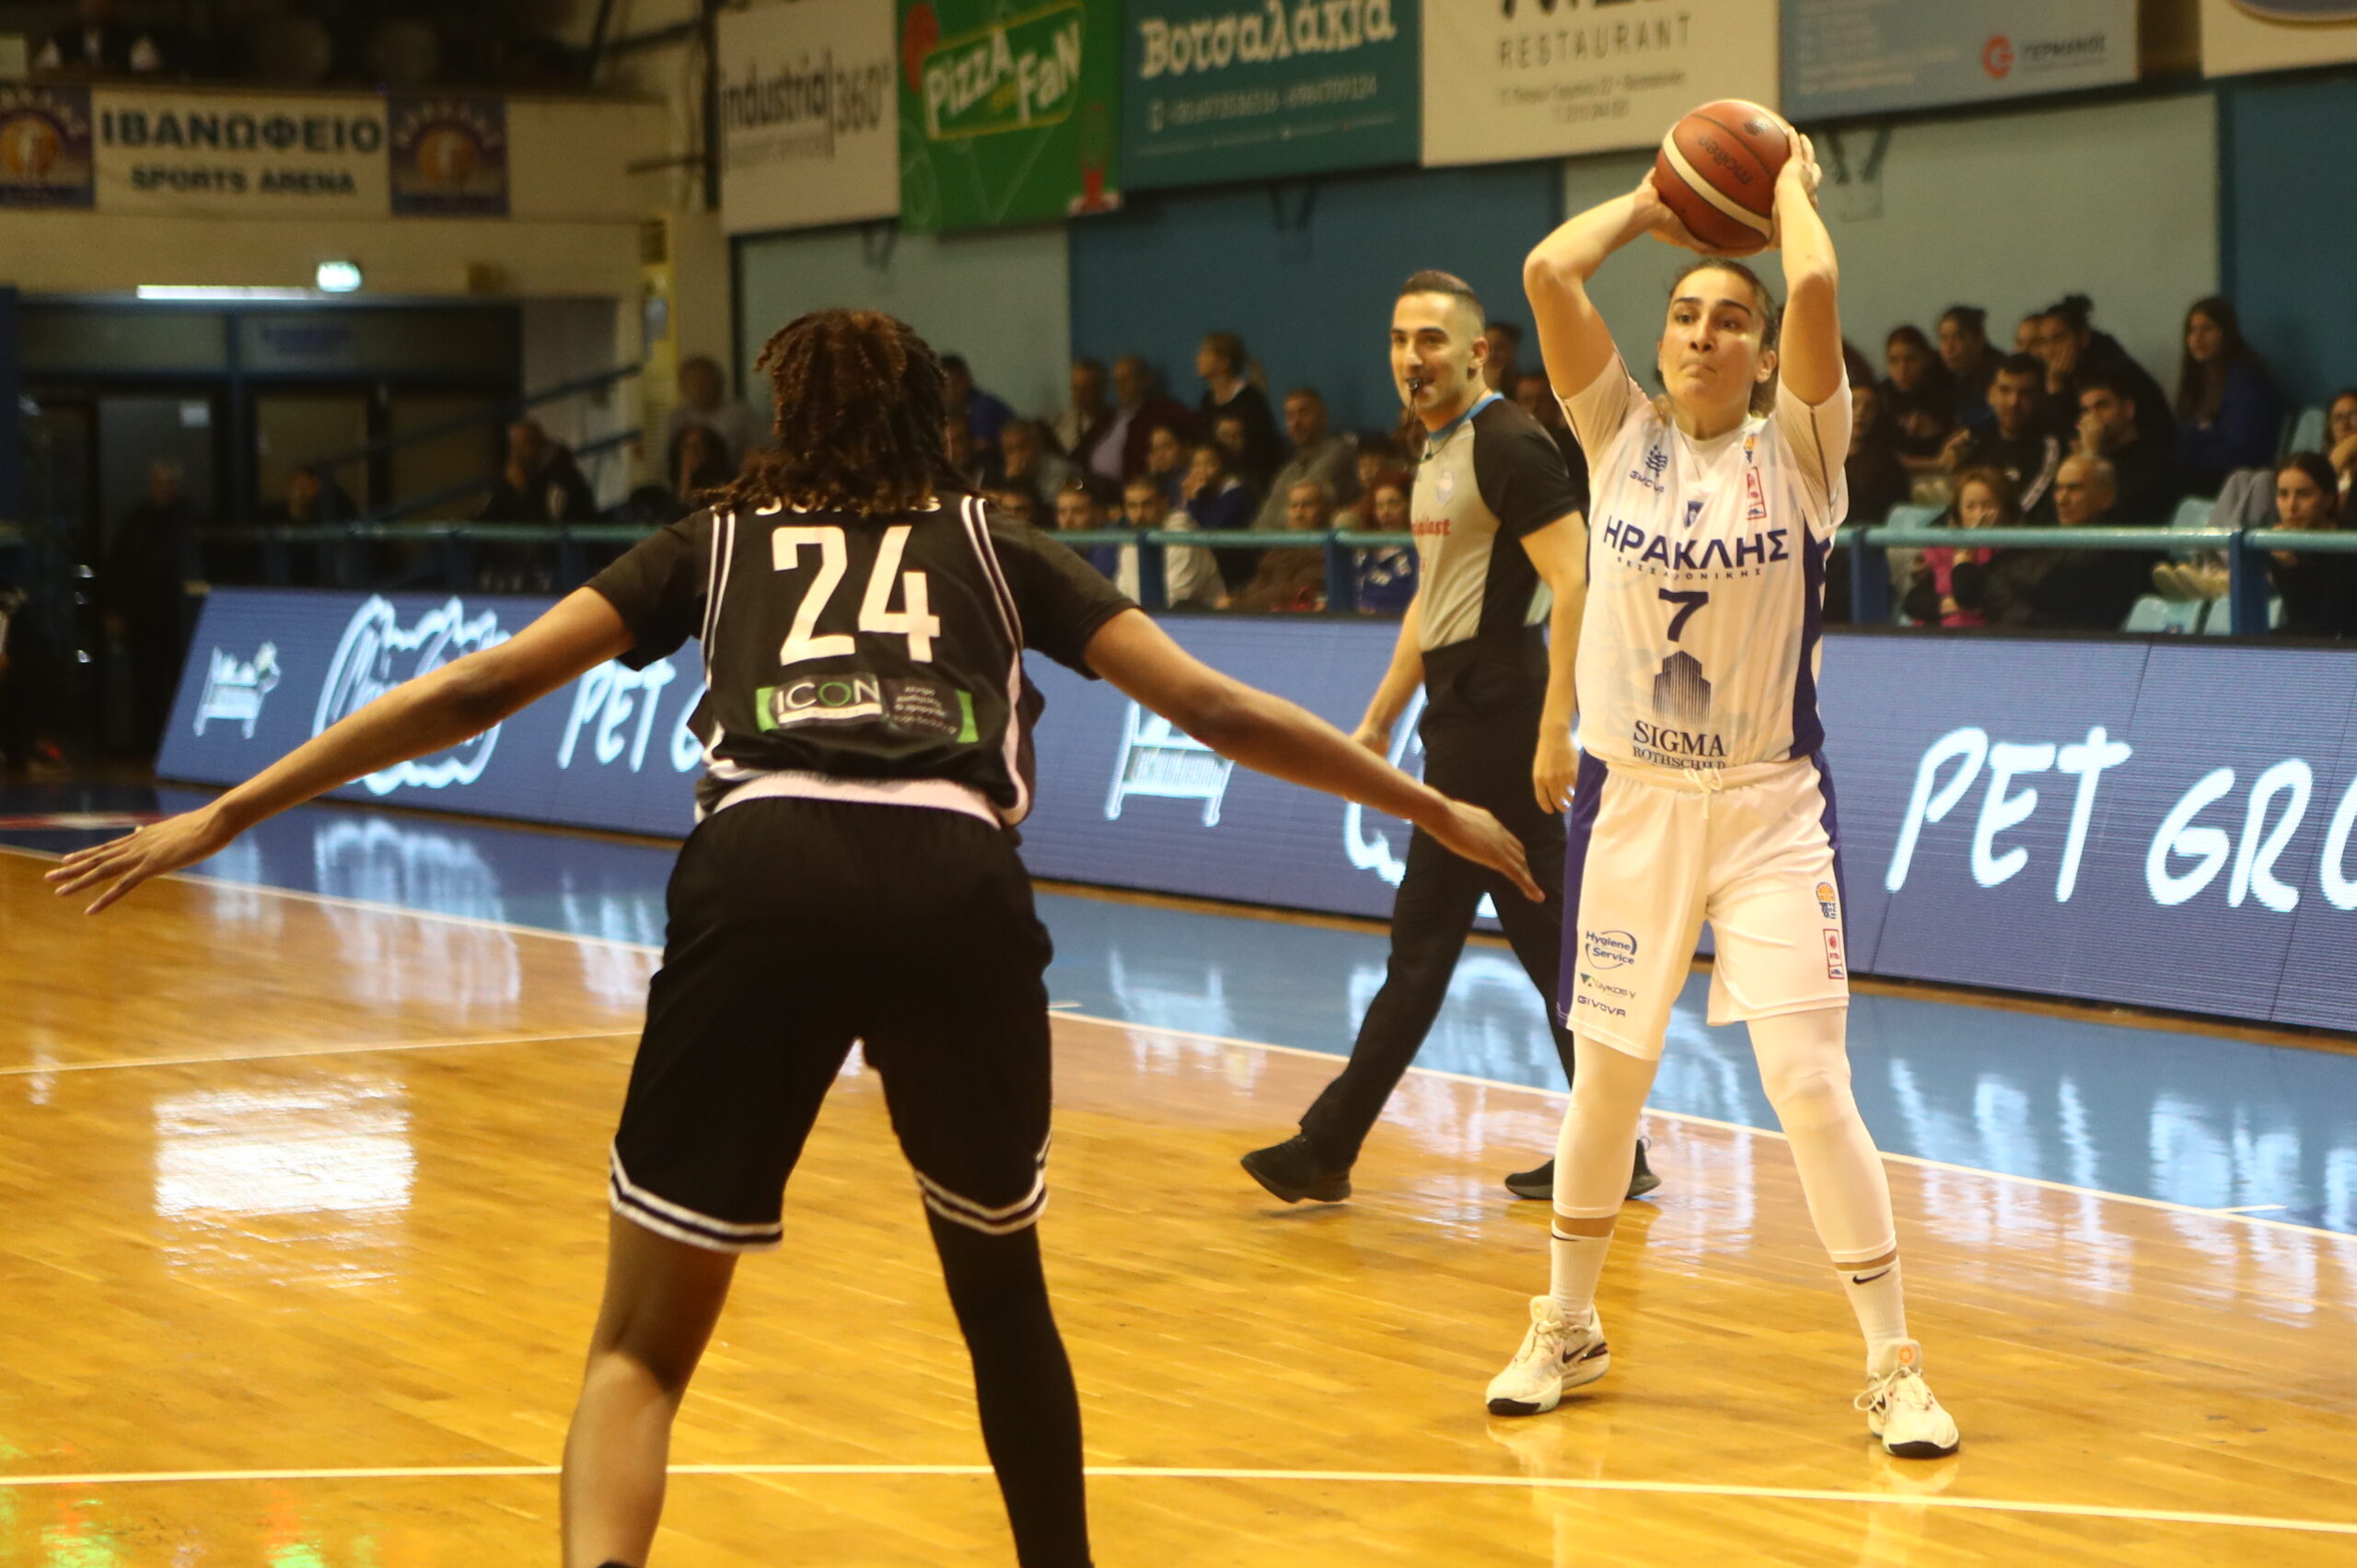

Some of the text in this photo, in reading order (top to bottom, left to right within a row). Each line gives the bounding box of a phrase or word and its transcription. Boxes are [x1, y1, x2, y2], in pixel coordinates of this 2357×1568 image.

[1498, 12, 1690, 69] RESTAURANT
[101, 109, 382, 154] ΙΒΑΝΩΦΕΙΟ
[131, 166, 357, 195] SPORTS ARENA
[1603, 514, 1789, 571] ΗΡΑΚΛΗΣ
[772, 526, 941, 667] 24
[1658, 587, 1710, 643] 7
[557, 656, 677, 773] PET
[777, 679, 881, 714] ICON
[1632, 719, 1727, 758] SIGMA
[1886, 726, 2133, 902] PET
[1585, 931, 1631, 951] Hygiene
[1592, 947, 1635, 965] Service
[1577, 995, 1627, 1017] GIVOVA
